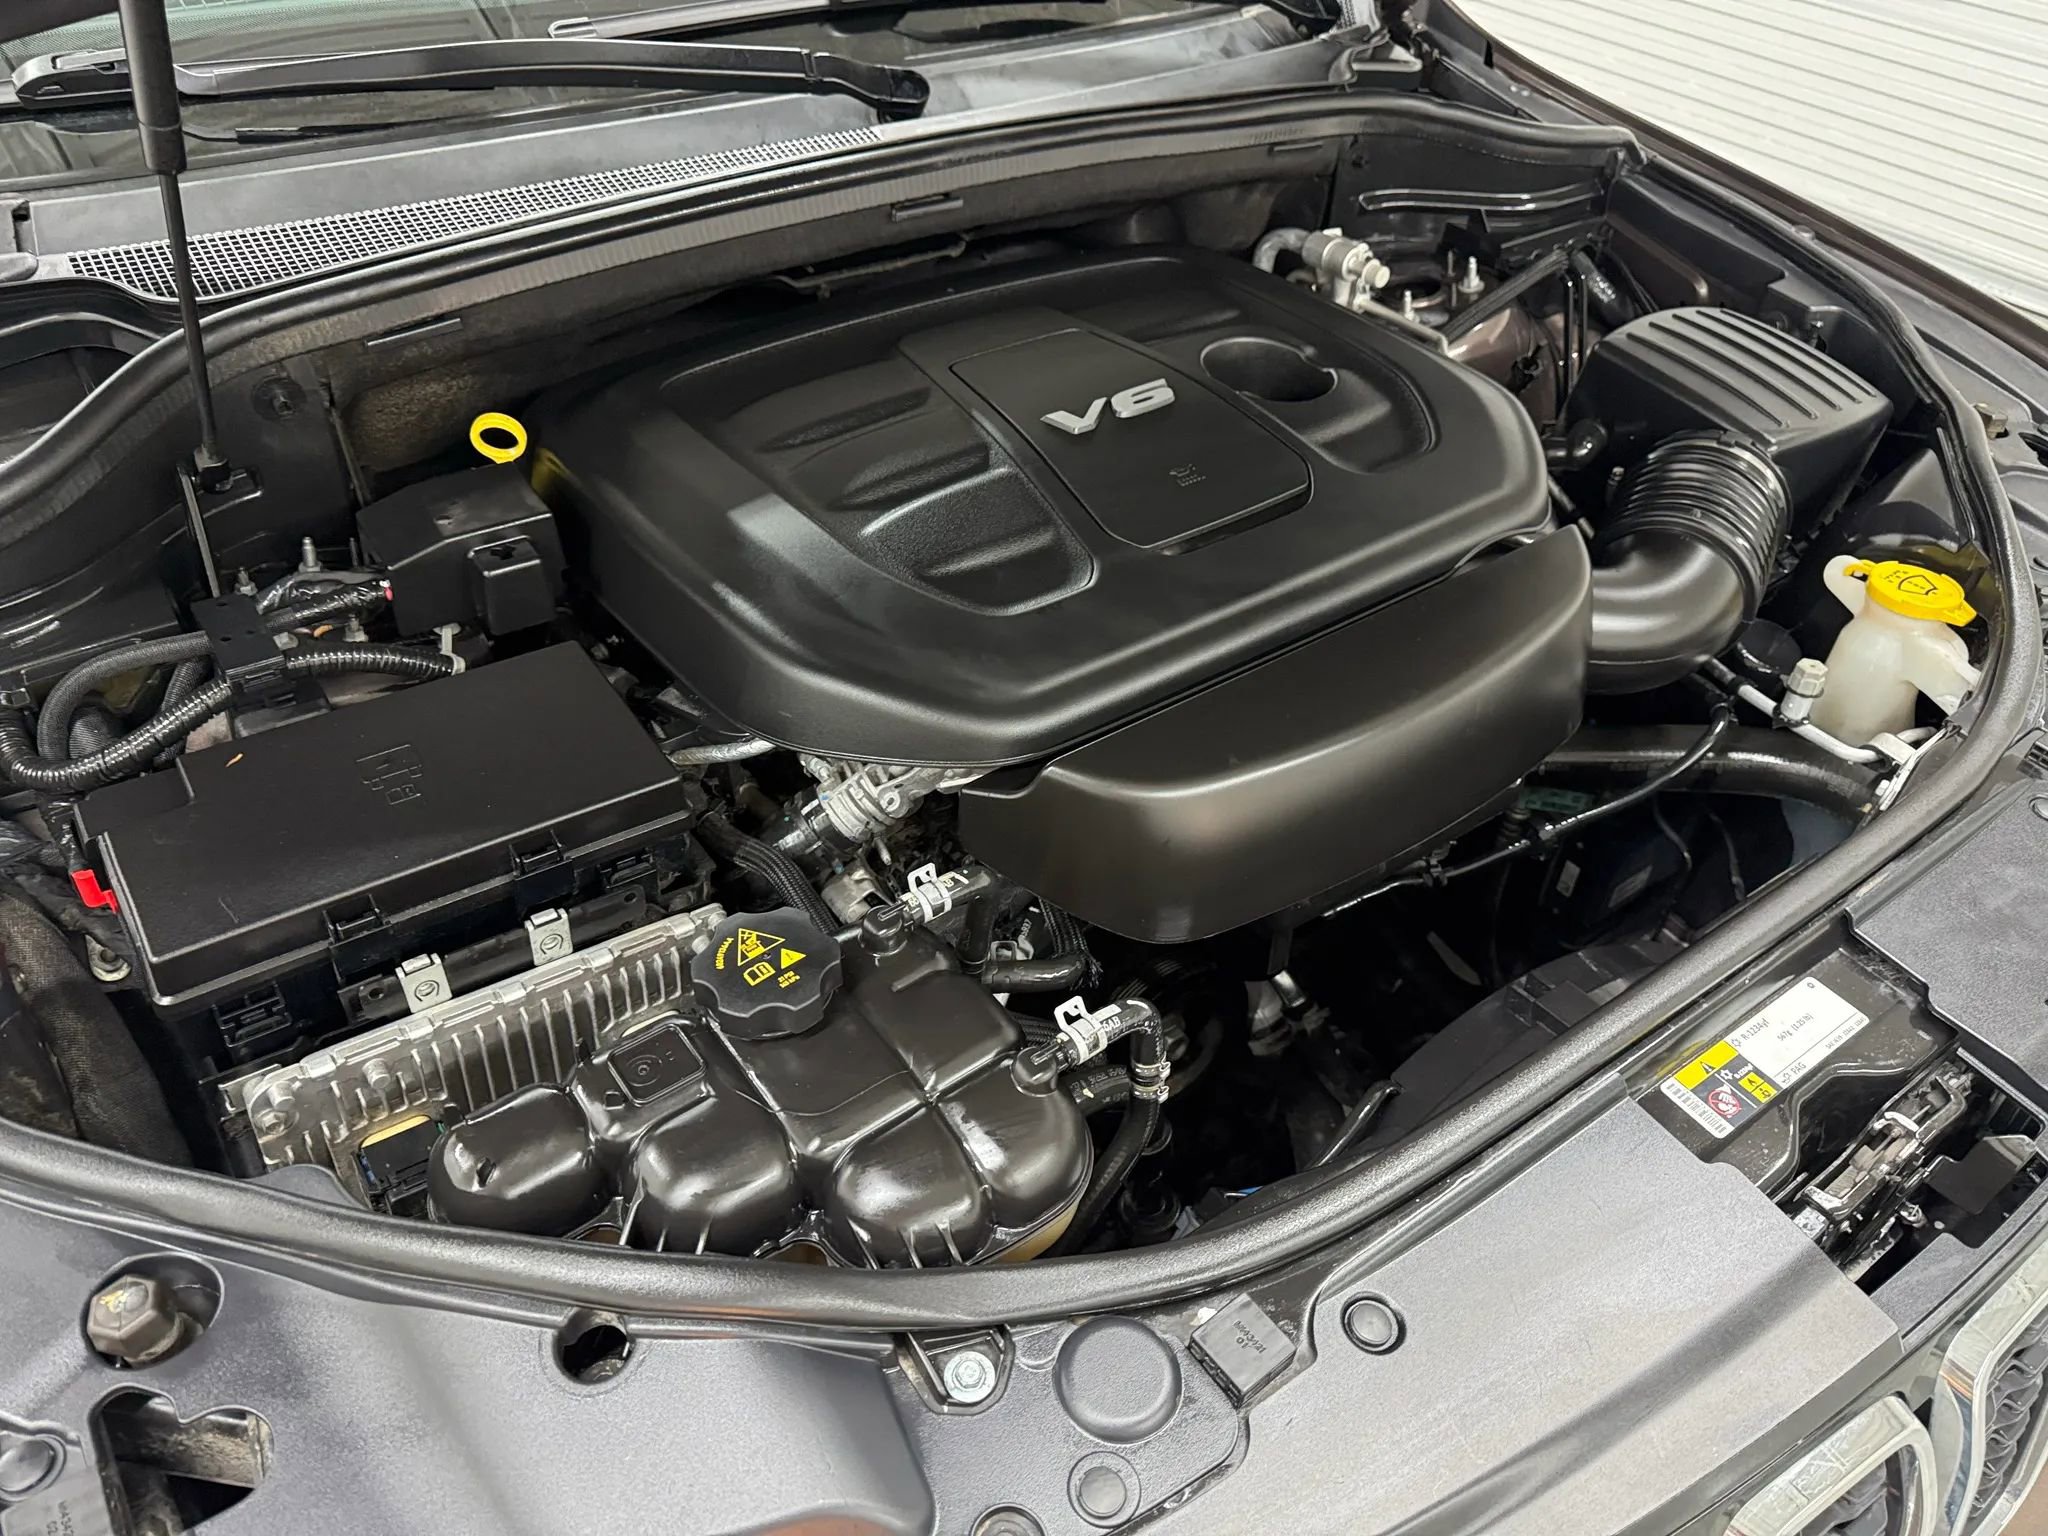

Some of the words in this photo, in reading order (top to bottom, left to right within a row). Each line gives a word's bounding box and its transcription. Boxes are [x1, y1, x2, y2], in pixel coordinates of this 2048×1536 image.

[1040, 378, 1175, 435] V6
[1740, 1018, 1770, 1041] R-1234yf
[1777, 1029, 1794, 1042] 567g
[1790, 1062, 1806, 1075] PAG
